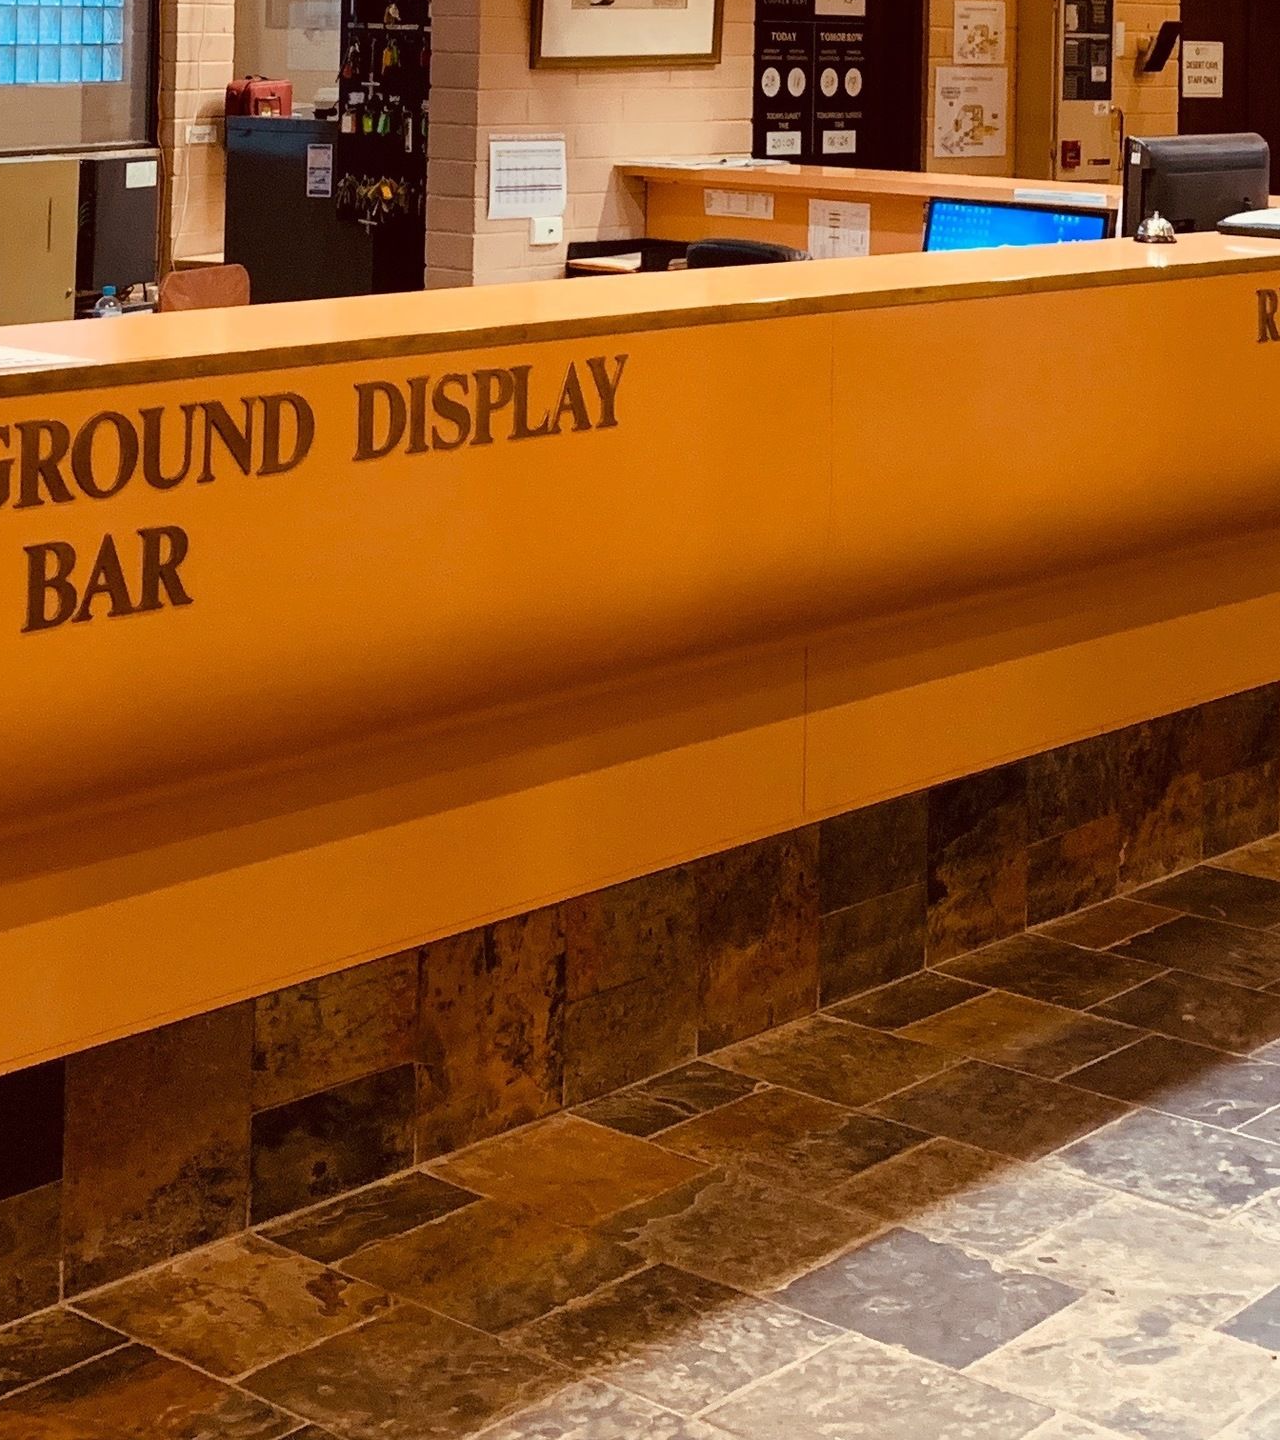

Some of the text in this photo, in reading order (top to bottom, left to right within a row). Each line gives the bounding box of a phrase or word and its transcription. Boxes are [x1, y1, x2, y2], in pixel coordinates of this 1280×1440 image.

[771, 32, 797, 41] TODAY
[820, 32, 863, 41] TOMORROW
[352, 354, 629, 462] DISPLAY
[20, 524, 194, 634] BAR
